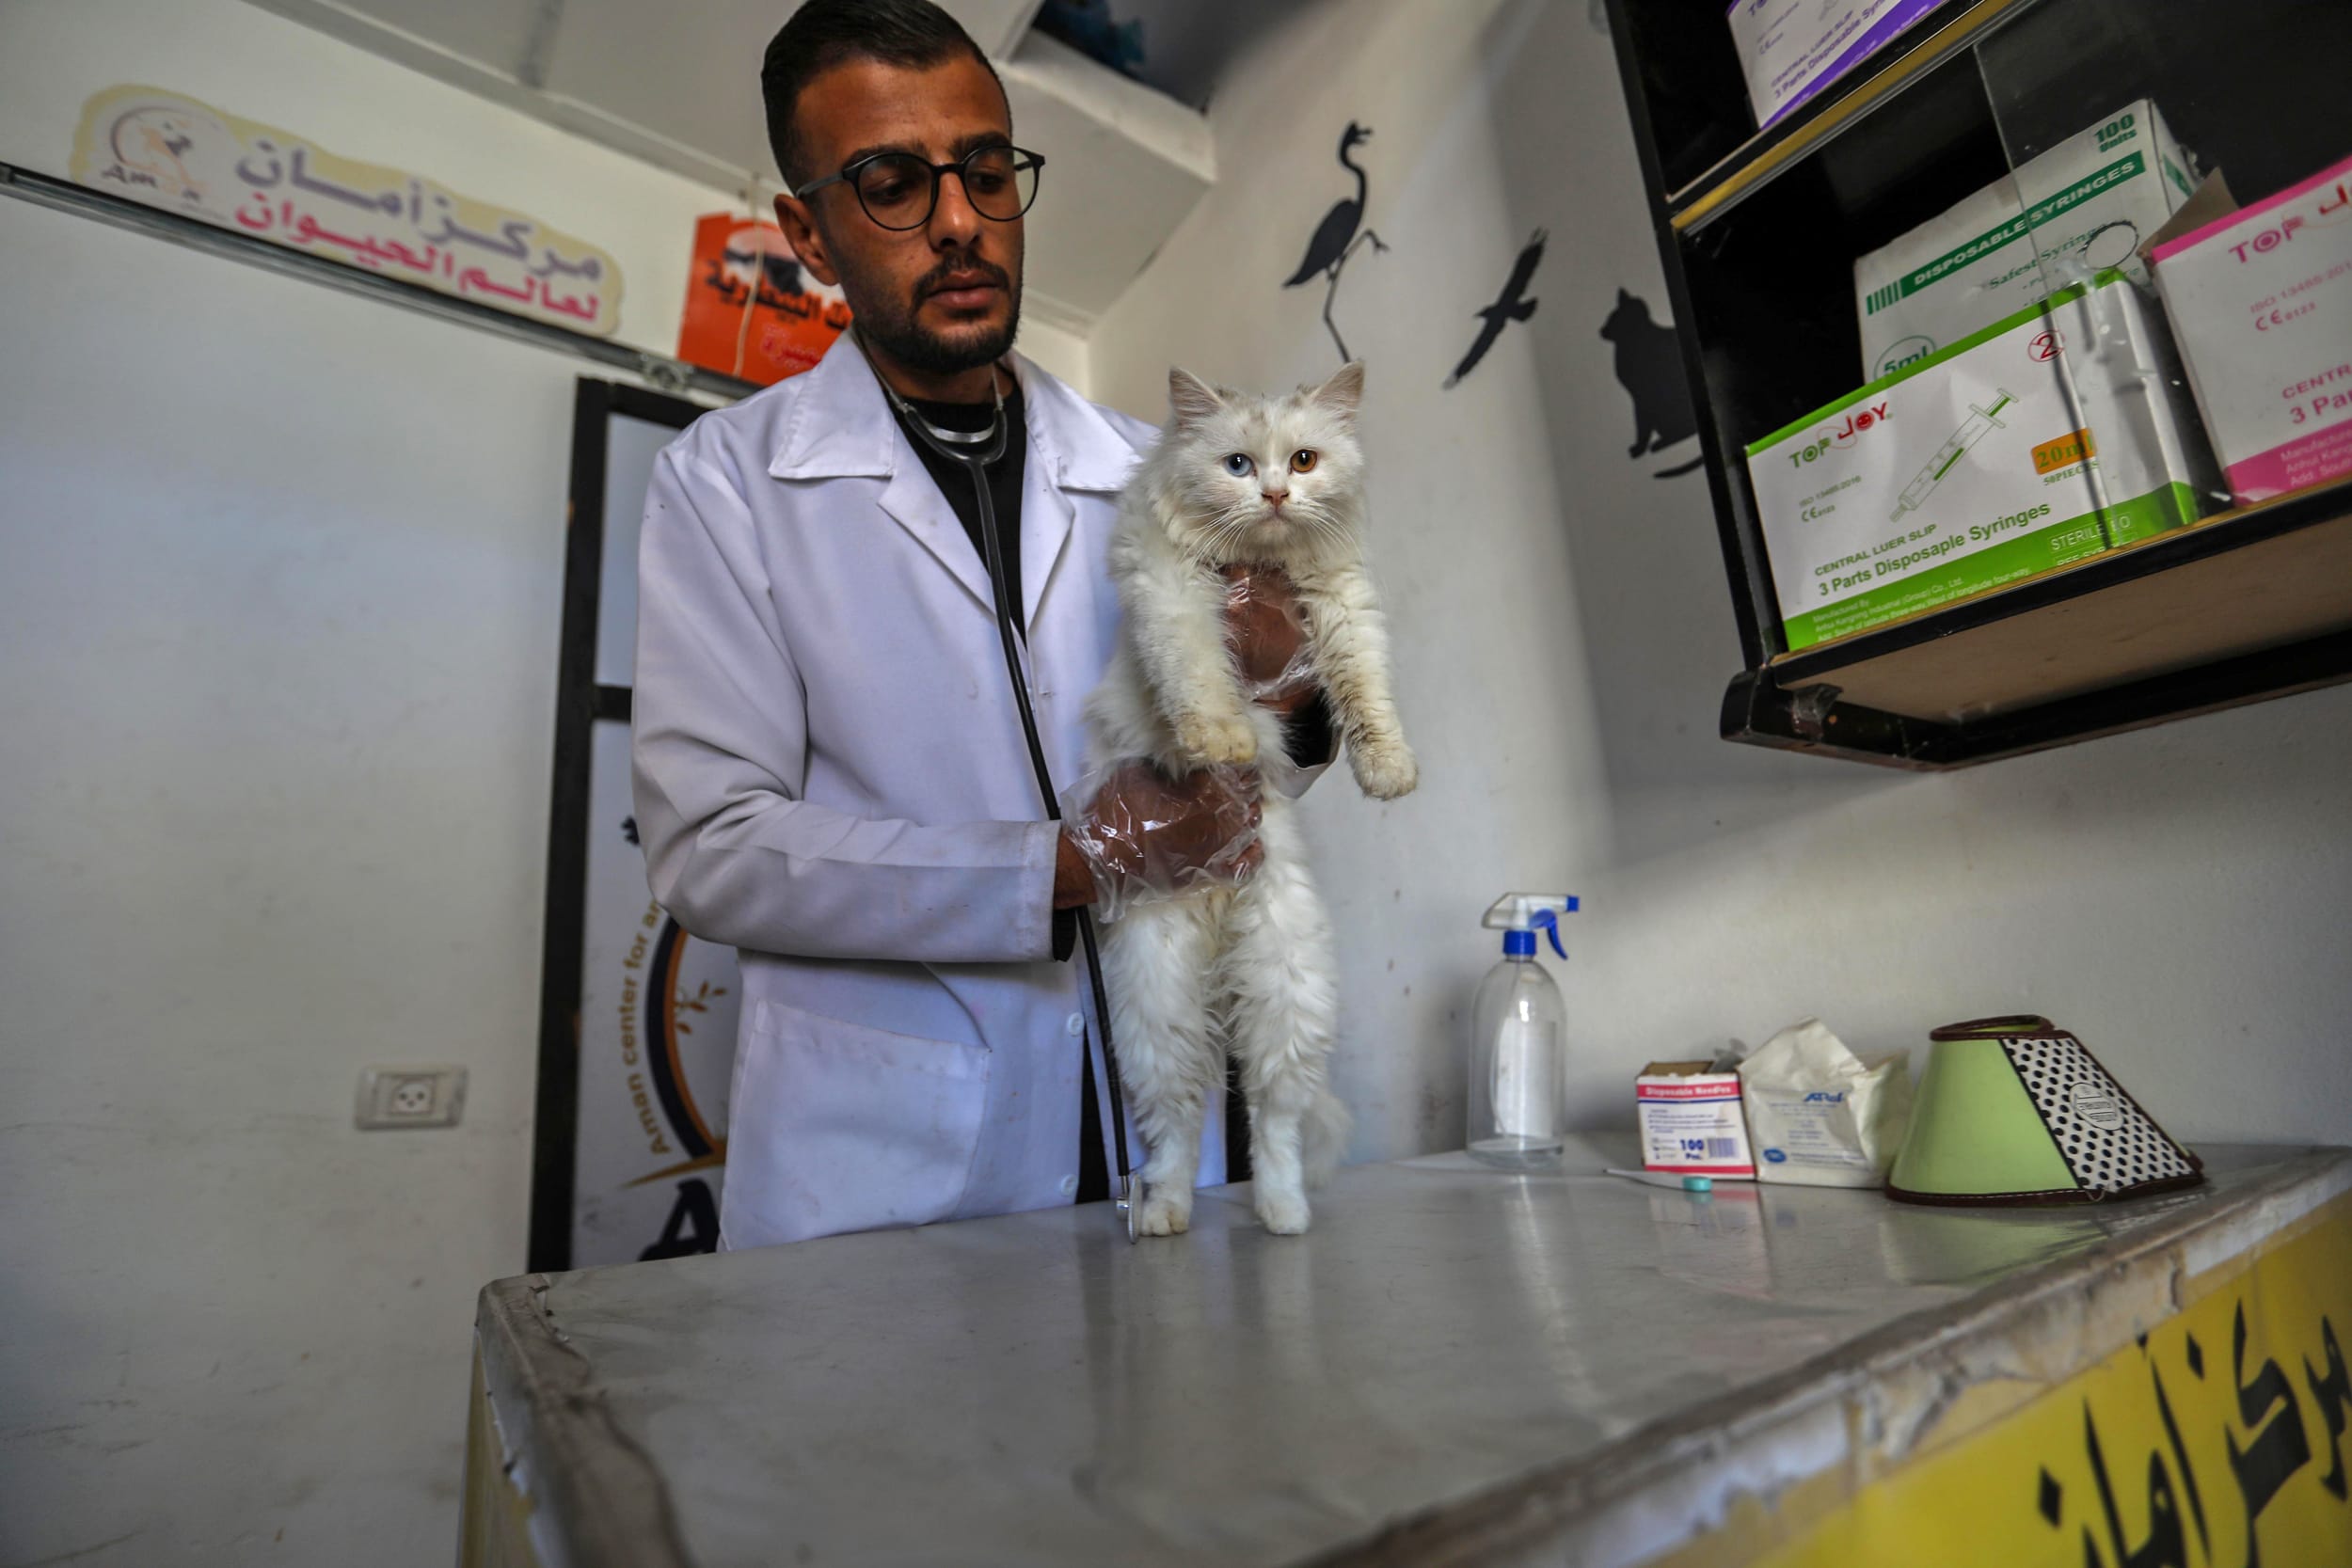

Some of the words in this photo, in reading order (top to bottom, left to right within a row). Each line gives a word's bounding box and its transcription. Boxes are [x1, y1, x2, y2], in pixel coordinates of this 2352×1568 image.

[2094, 113, 2136, 143] 100
[2099, 129, 2137, 153] Units
[1913, 218, 2028, 286] DISPOSABLE
[2028, 160, 2137, 222] SYRINGES
[2228, 215, 2305, 264] TOP
[2318, 183, 2352, 216] J
[1788, 437, 1831, 468] TOP
[1837, 401, 1887, 440] JOY
[2289, 405, 2307, 424] 3
[1815, 550, 1870, 577] CENTRAL
[1872, 535, 1906, 556] LUER
[1908, 523, 1937, 543] SLIP
[1819, 581, 1829, 596] 3
[1834, 569, 1872, 592] Parts
[1874, 533, 1966, 577] Disposaple
[1968, 502, 2051, 542] Syringes
[622, 931, 648, 970] for
[619, 974, 640, 1067] center
[626, 1072, 672, 1155] Aman
[1679, 1138, 1704, 1151] 100
